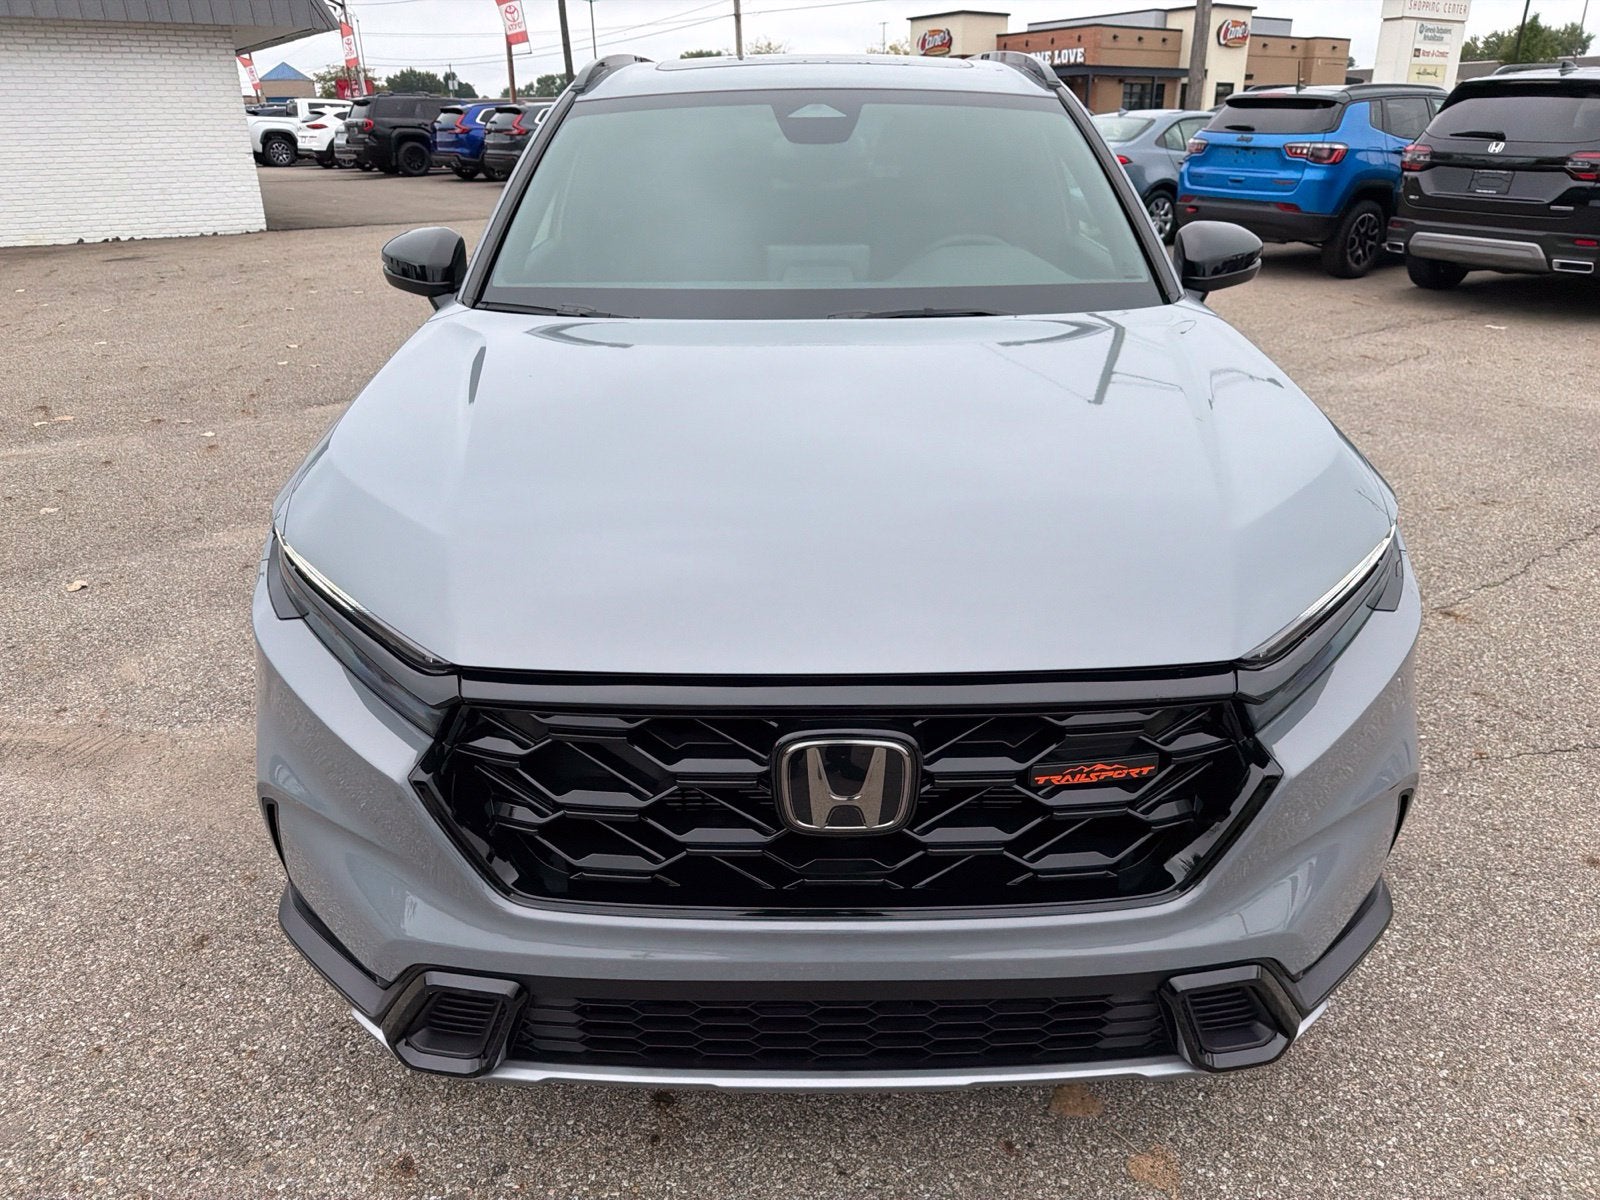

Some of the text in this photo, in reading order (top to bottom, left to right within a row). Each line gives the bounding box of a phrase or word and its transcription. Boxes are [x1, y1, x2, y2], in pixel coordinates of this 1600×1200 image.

[1408, 0, 1467, 15] SHOPPING CENTER
[1054, 48, 1085, 65] LOVE
[1034, 765, 1156, 785] TRAILSPORT
